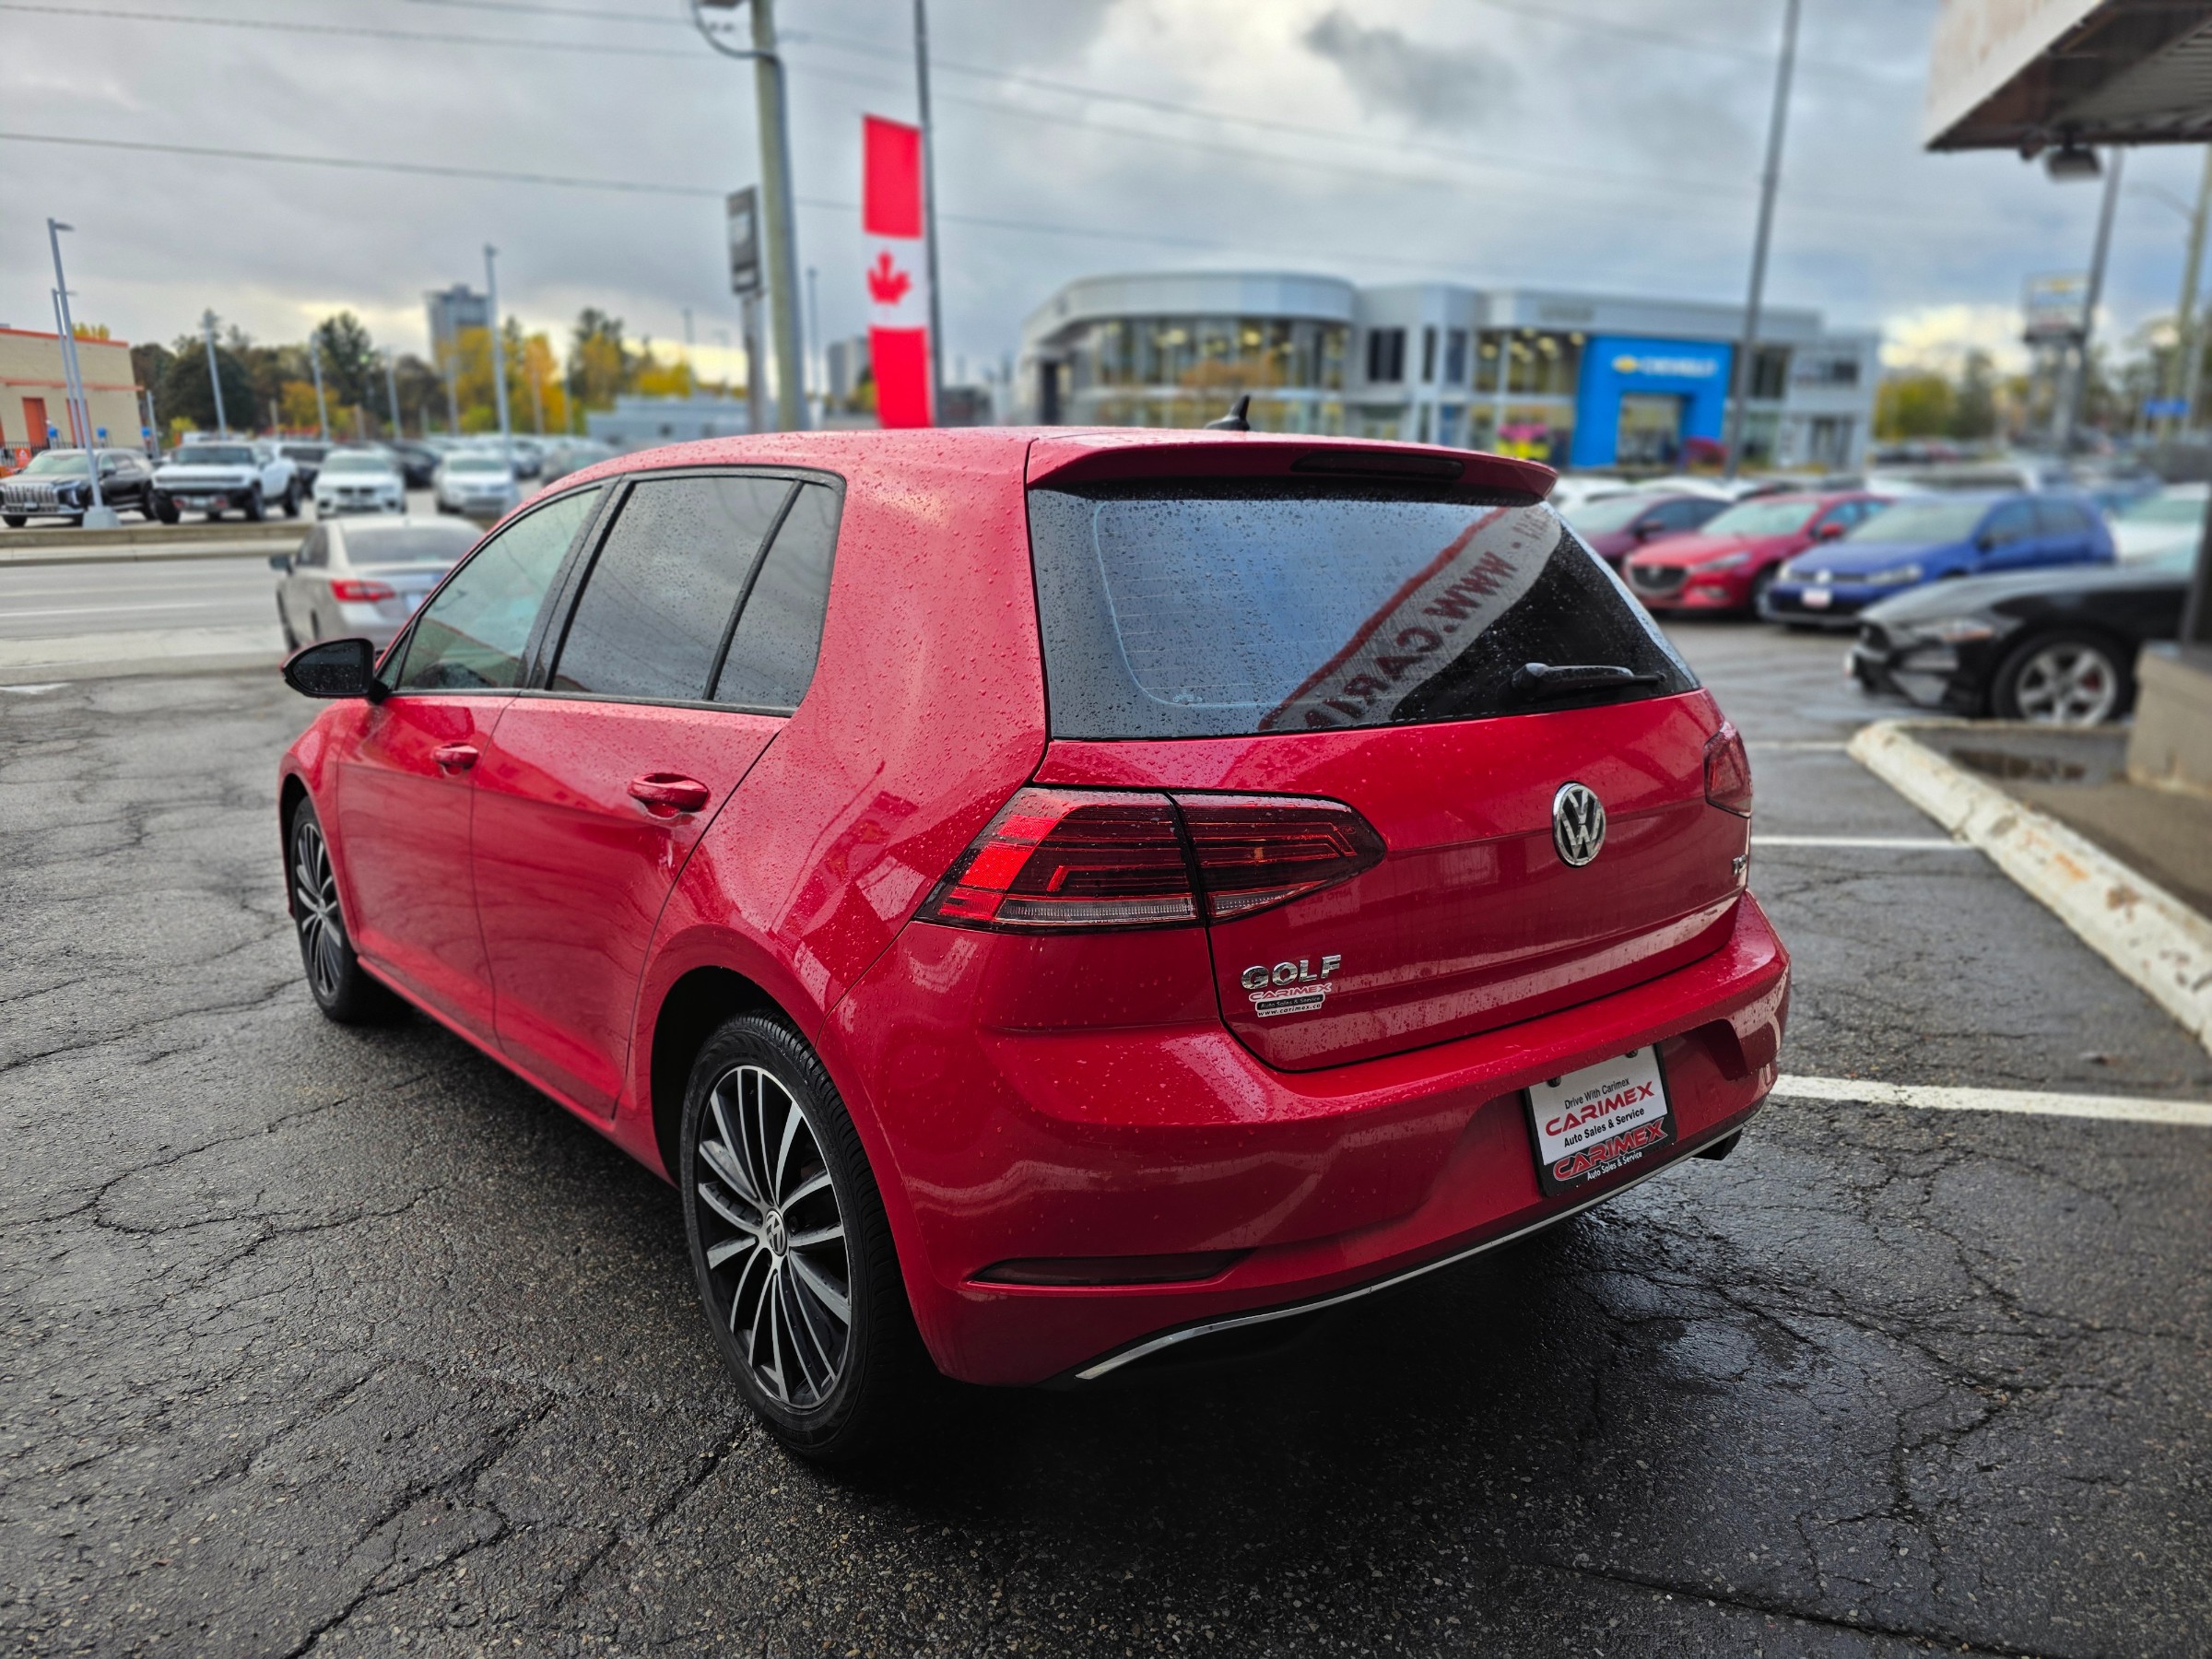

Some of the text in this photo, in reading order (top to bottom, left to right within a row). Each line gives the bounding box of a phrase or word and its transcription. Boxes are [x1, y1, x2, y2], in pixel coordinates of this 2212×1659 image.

[1241, 954, 1341, 990] GOLF
[1249, 983, 1331, 1000] CARIMEX
[1300, 995, 1321, 1004] Service
[1545, 1081, 1655, 1136] CARIMEX
[1564, 1078, 1630, 1110] Drive With Carimex
[1564, 1108, 1645, 1147] Auto Sales & Service
[1553, 1117, 1668, 1181] CARIMEX
[1587, 1151, 1642, 1181] Auto Sales & Service
